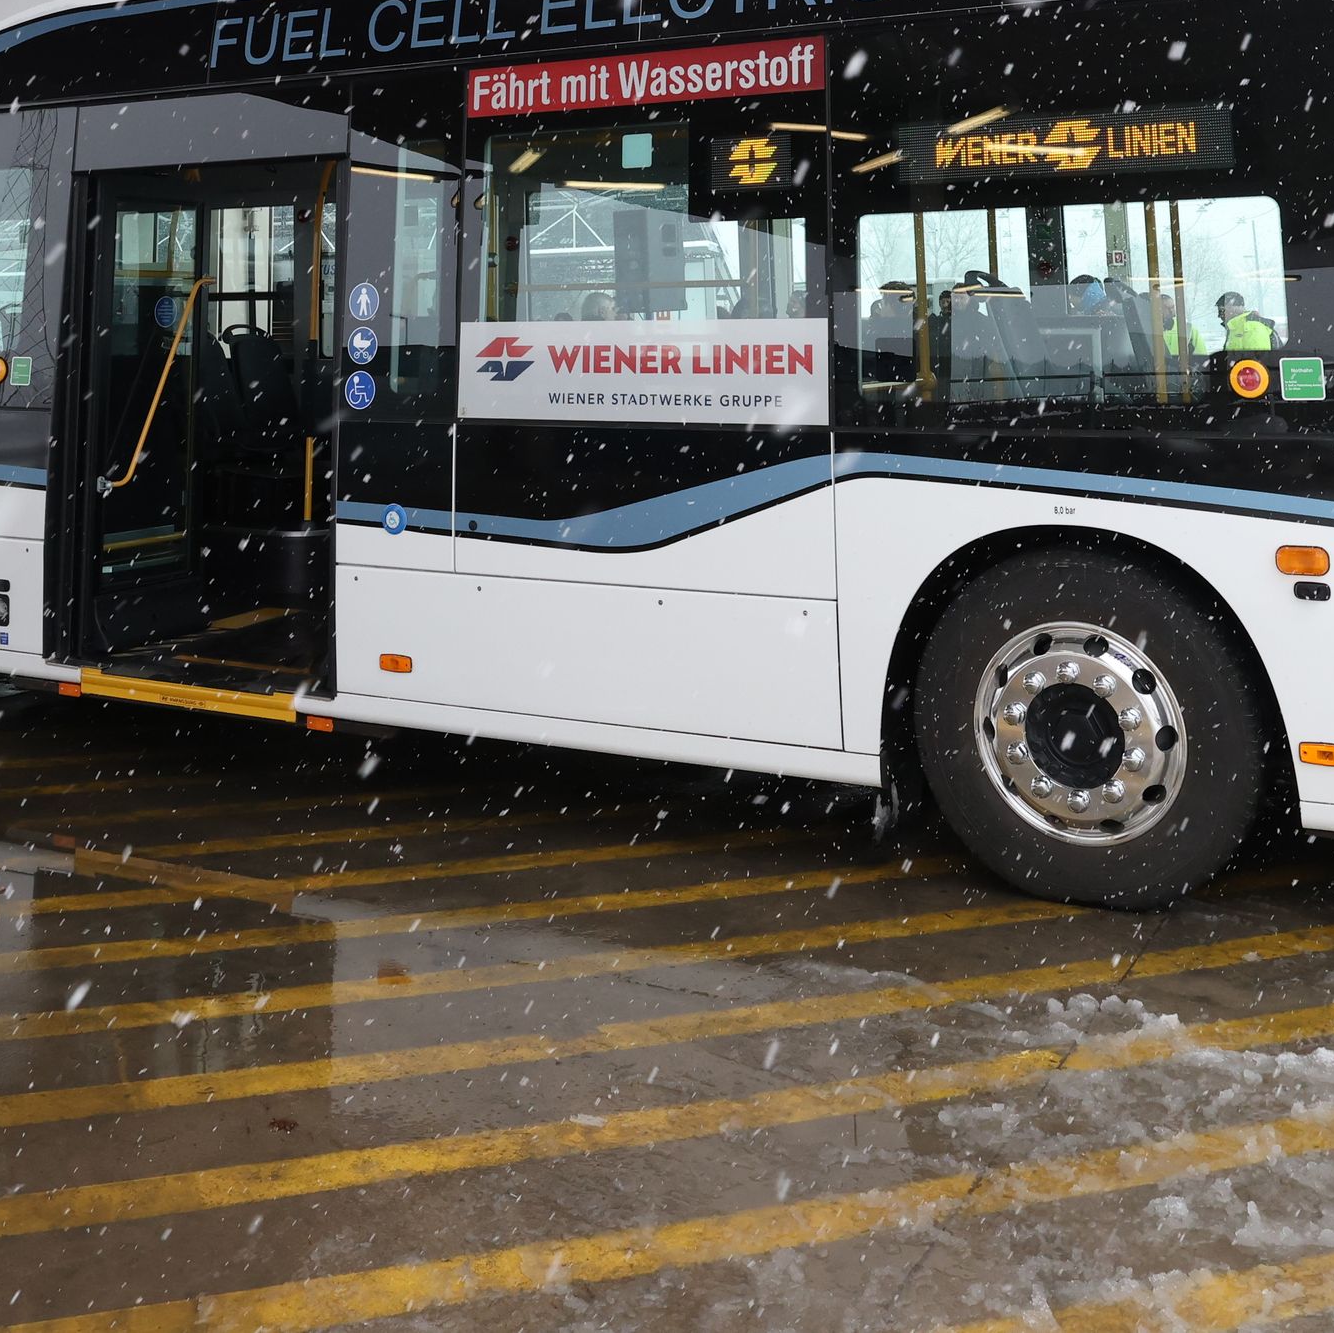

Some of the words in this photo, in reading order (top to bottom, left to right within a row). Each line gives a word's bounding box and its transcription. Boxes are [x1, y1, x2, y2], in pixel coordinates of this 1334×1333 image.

[210, 7, 346, 69] FUEL
[473, 70, 551, 112] Fährt
[560, 65, 610, 105] mit
[618, 44, 815, 100] Wasserstoff
[1107, 121, 1197, 158] LINIEN
[547, 344, 682, 375] WIENER
[692, 343, 814, 376] LINIEN
[548, 392, 605, 405] WIENER
[611, 393, 712, 407] STADTWERKE
[719, 394, 782, 408] GRUPPE
[1065, 506, 1076, 515] bar
